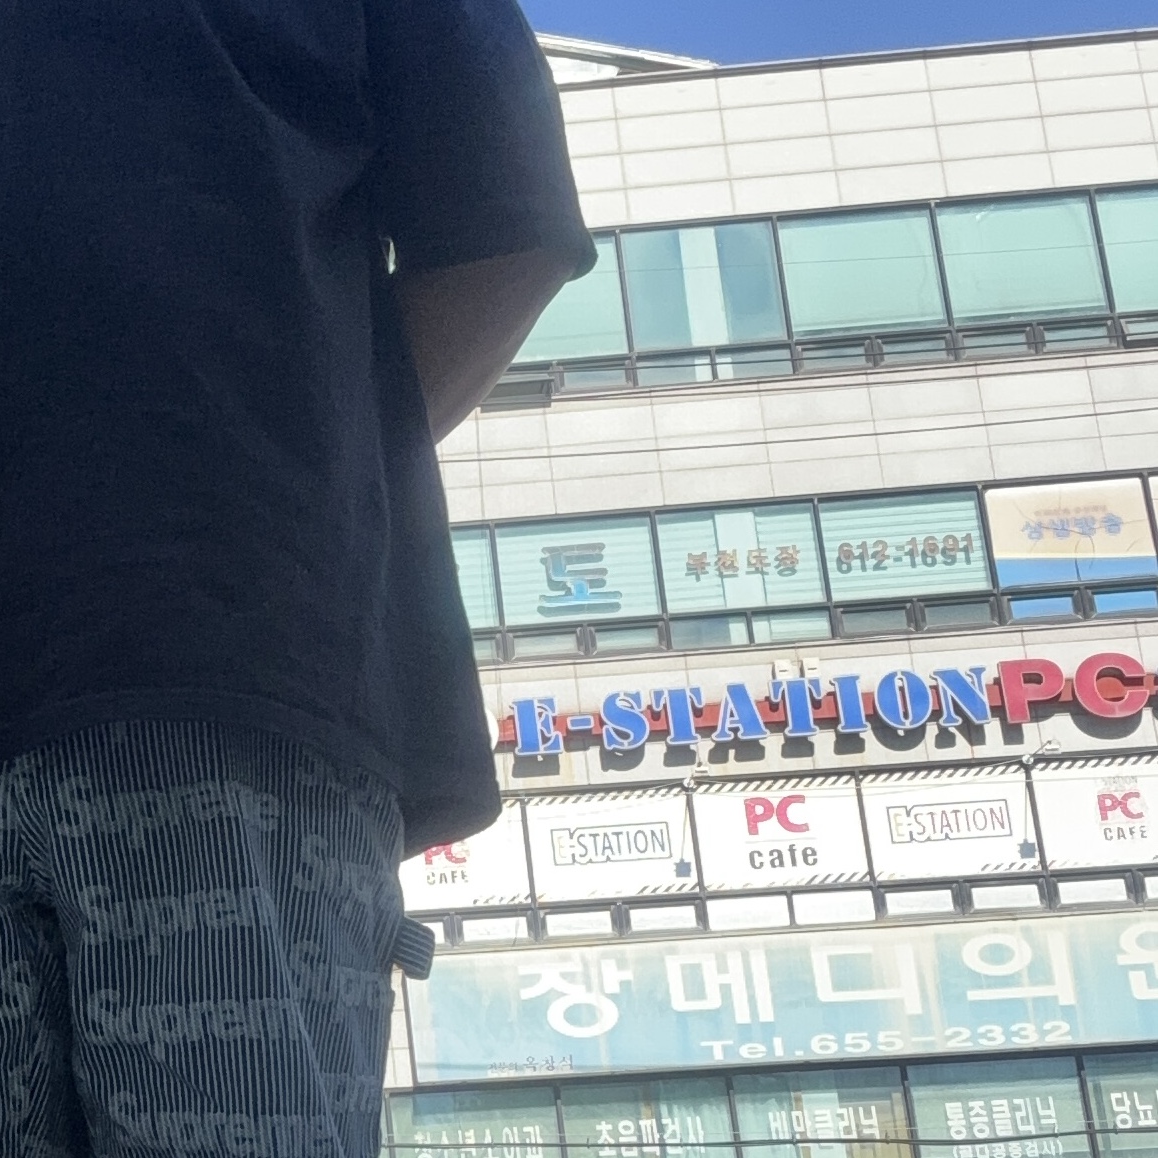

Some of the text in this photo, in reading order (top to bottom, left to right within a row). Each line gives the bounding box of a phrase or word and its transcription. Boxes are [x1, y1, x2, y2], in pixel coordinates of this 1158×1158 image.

[837, 533, 974, 569] 612-1691
[509, 652, 1151, 757] E-STATION PC
[743, 794, 810, 836] PC
[894, 806, 1006, 837] E-STATION
[1097, 792, 1144, 821] PC
[556, 828, 667, 859] E-STATION
[1103, 825, 1147, 841] CAFE
[426, 869, 469, 885] CAFE
[748, 844, 818, 870] cafe
[78, 884, 277, 956] Suprem
[87, 988, 300, 1062] Suprem
[700, 1020, 1073, 1061] Tel.655-2332
[944, 1096, 1058, 1140] 통증클리닉
[1110, 1089, 1158, 1129] 당뇨
[595, 1116, 706, 1157] 초음파검사
